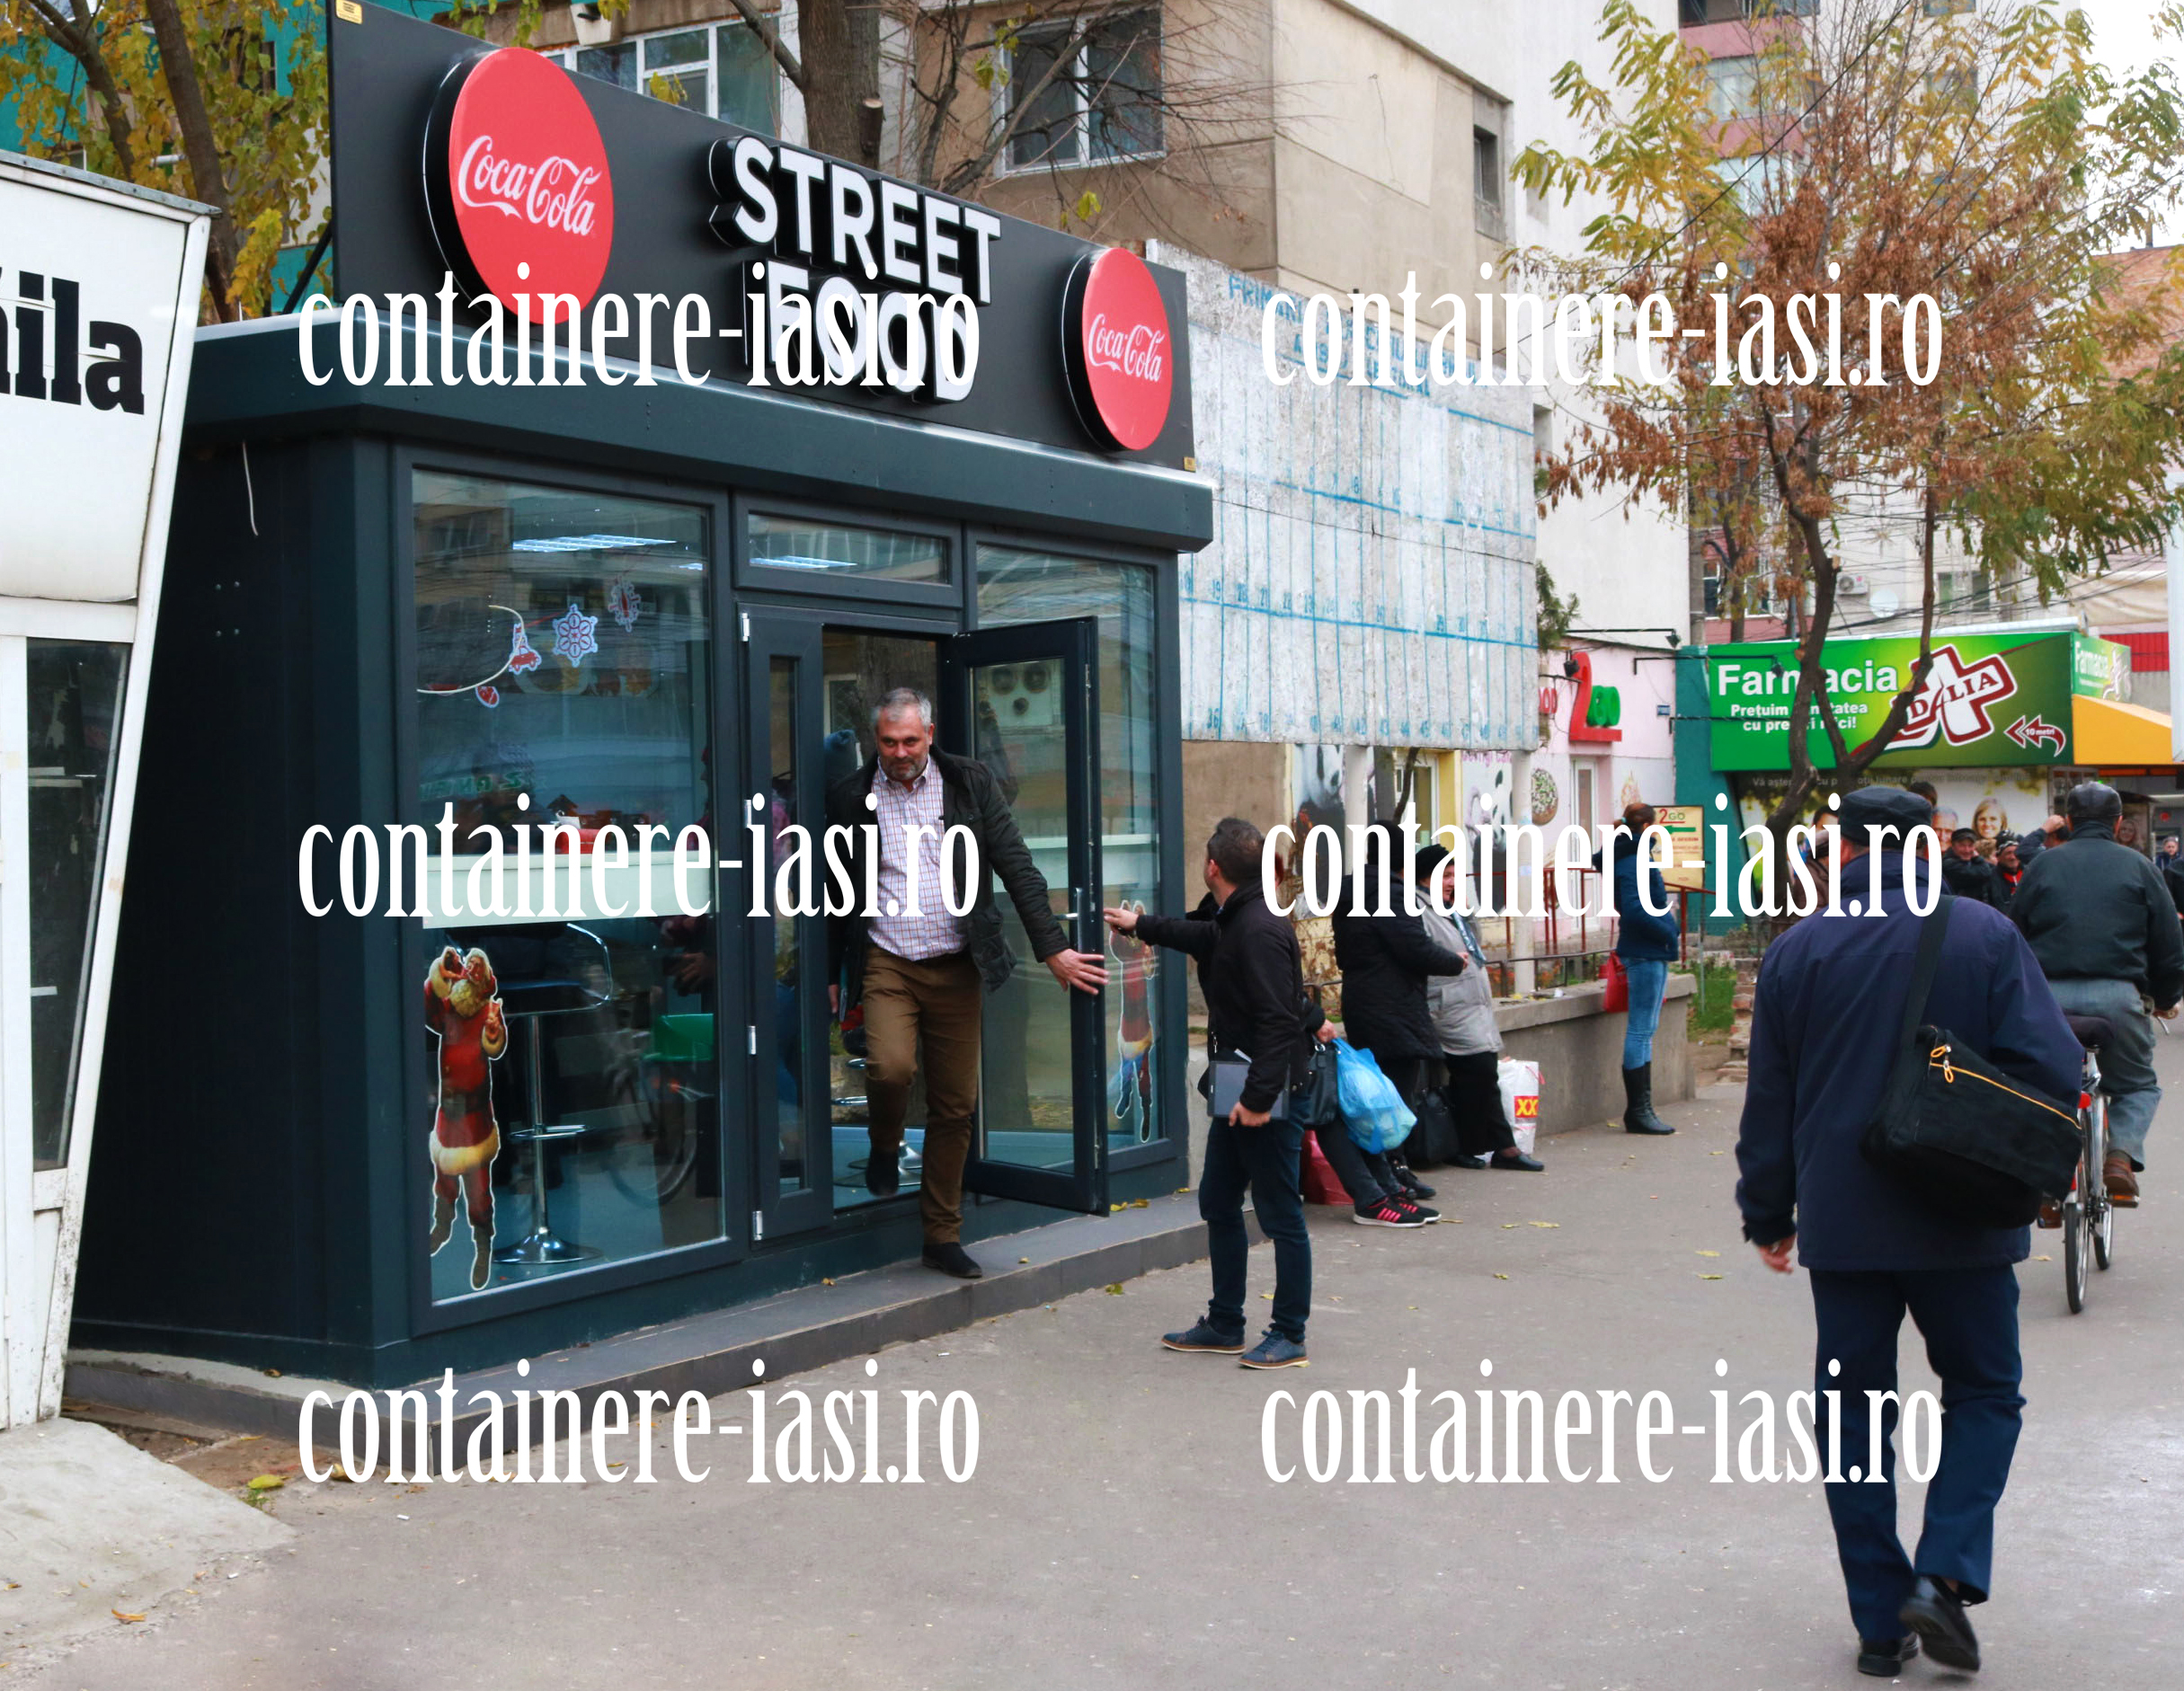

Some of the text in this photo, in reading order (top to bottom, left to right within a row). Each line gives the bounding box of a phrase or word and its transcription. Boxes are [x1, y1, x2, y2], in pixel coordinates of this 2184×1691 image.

[458, 135, 601, 236] Coca-Cola
[732, 136, 1002, 306] STREET
[0, 268, 144, 414] ila
[1088, 313, 1165, 383] Coca-Cola
[1743, 722, 1761, 731] cu
